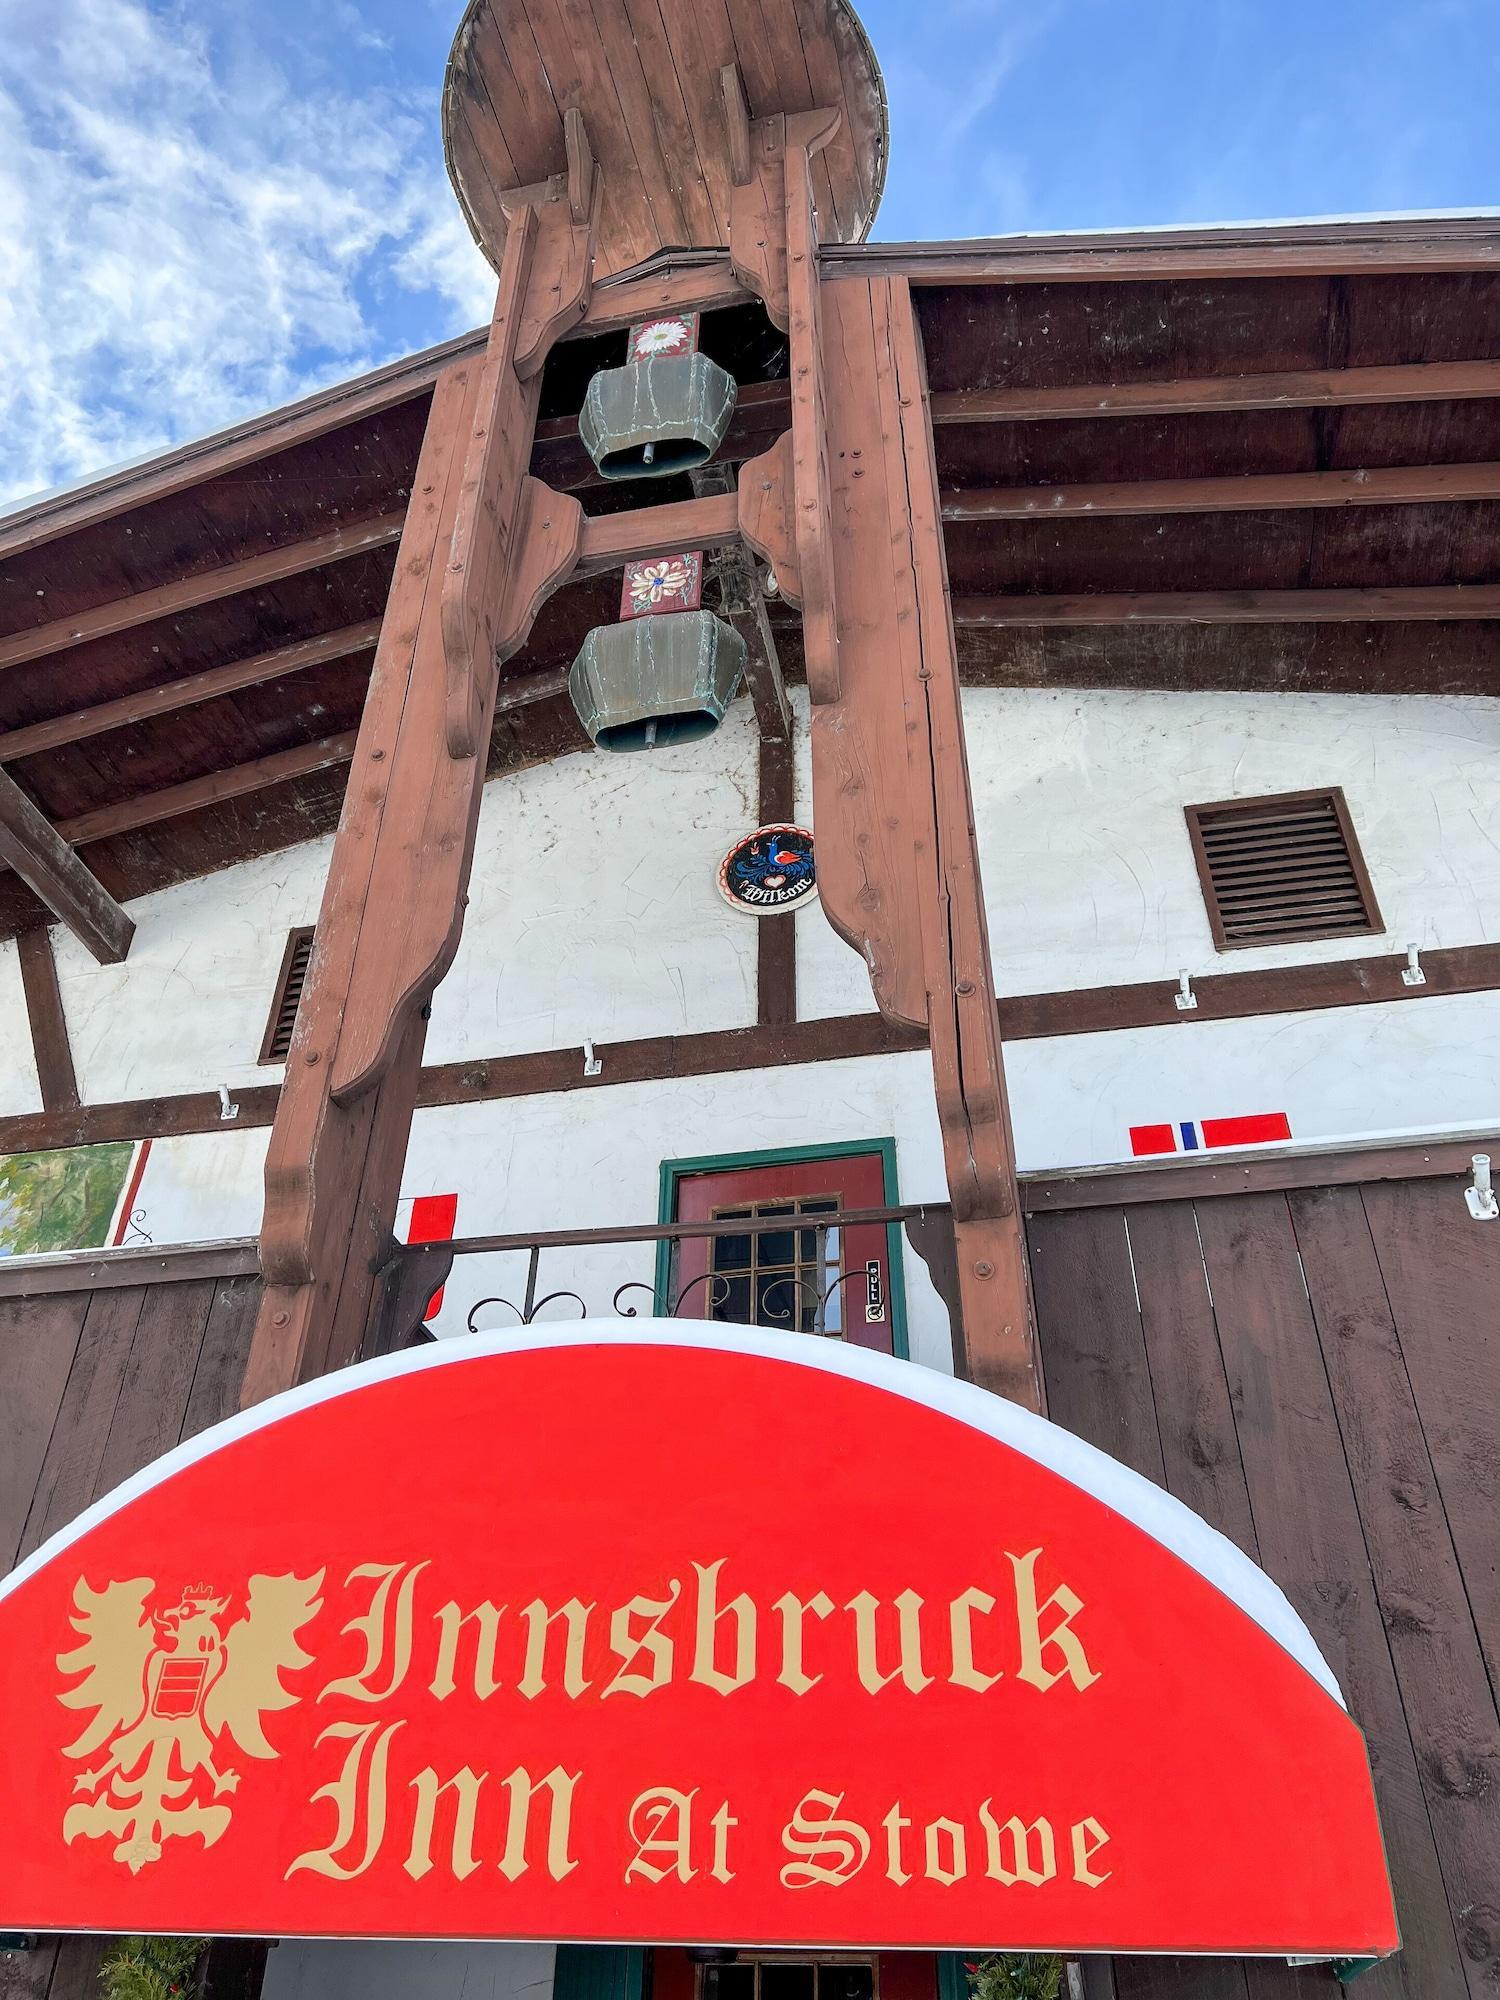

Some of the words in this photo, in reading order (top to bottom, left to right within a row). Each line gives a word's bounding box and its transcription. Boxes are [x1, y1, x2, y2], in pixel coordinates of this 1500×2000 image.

[870, 1267, 878, 1300] PULL
[315, 1547, 1103, 1705] Innsbruck
[283, 1719, 583, 1883] Inn
[624, 1786, 739, 1885] At
[779, 1788, 1113, 1889] Stowe
